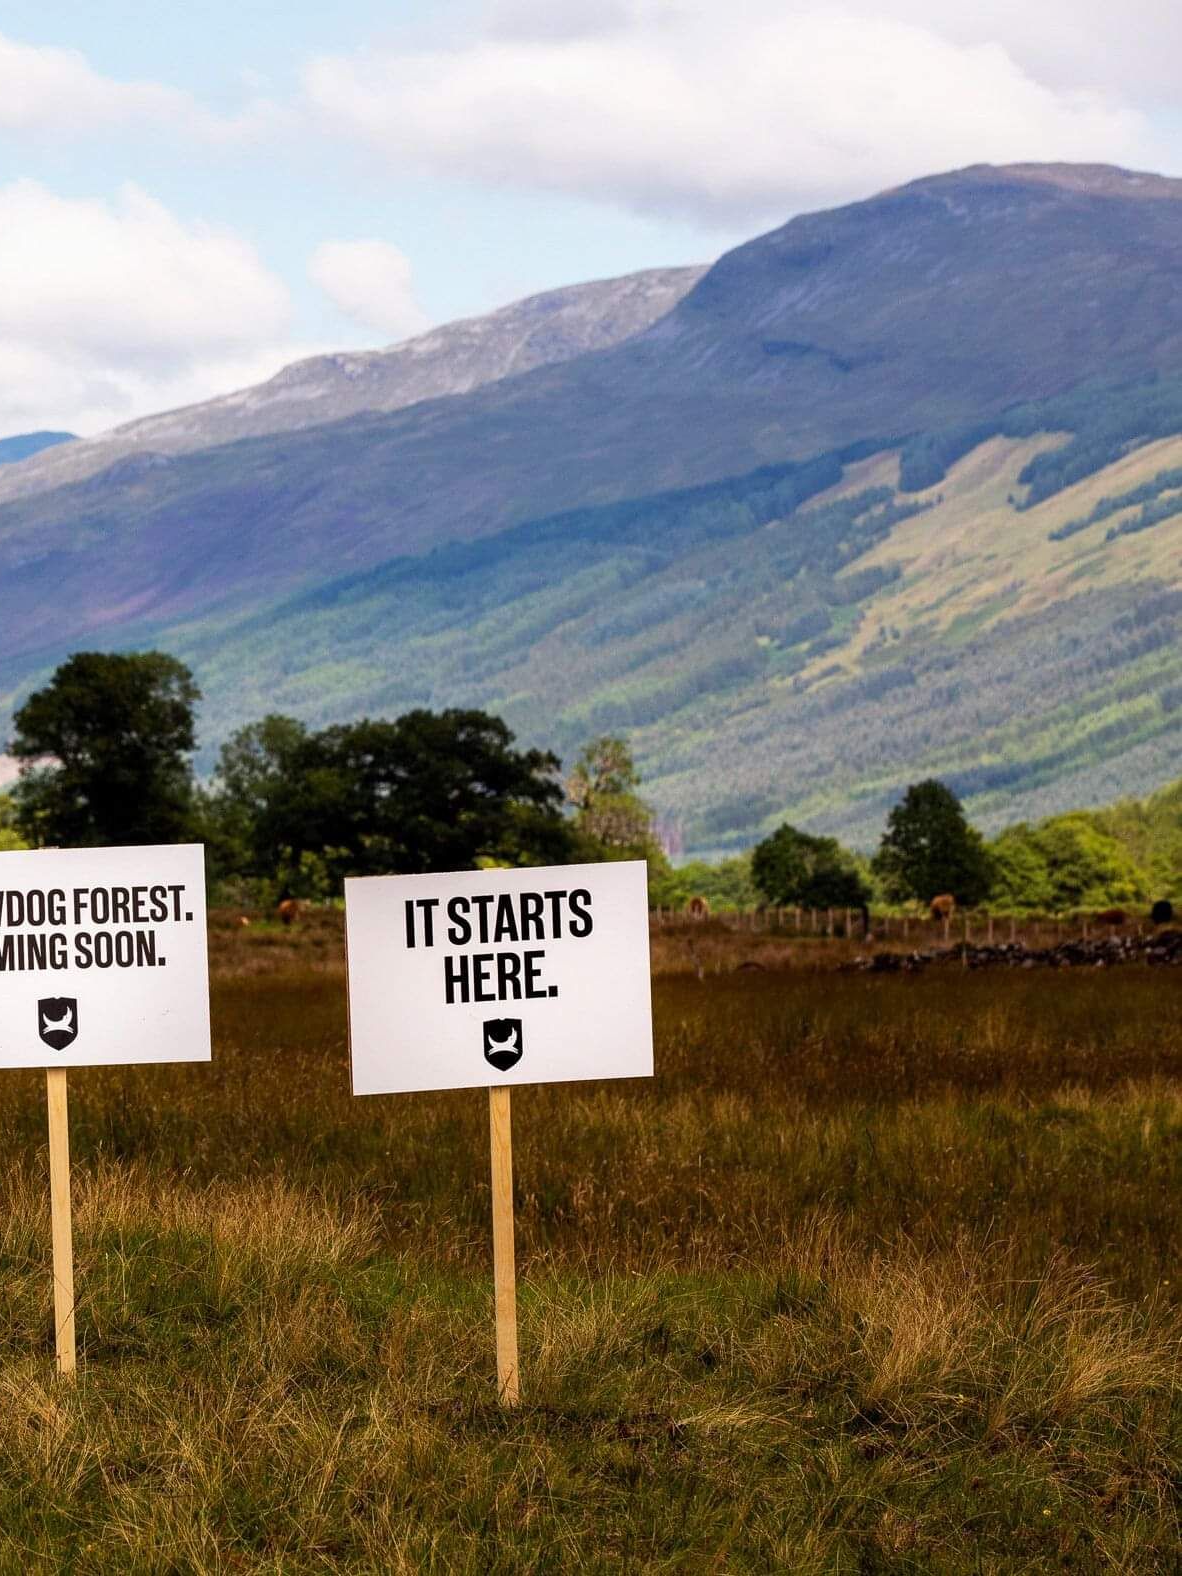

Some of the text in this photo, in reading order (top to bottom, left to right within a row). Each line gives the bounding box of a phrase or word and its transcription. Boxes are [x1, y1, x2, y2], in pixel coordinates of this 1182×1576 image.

[73, 886, 194, 926] FOREST.
[404, 888, 593, 949] IT STARTS
[74, 930, 166, 970] SOON.
[444, 949, 559, 1005] HERE.
